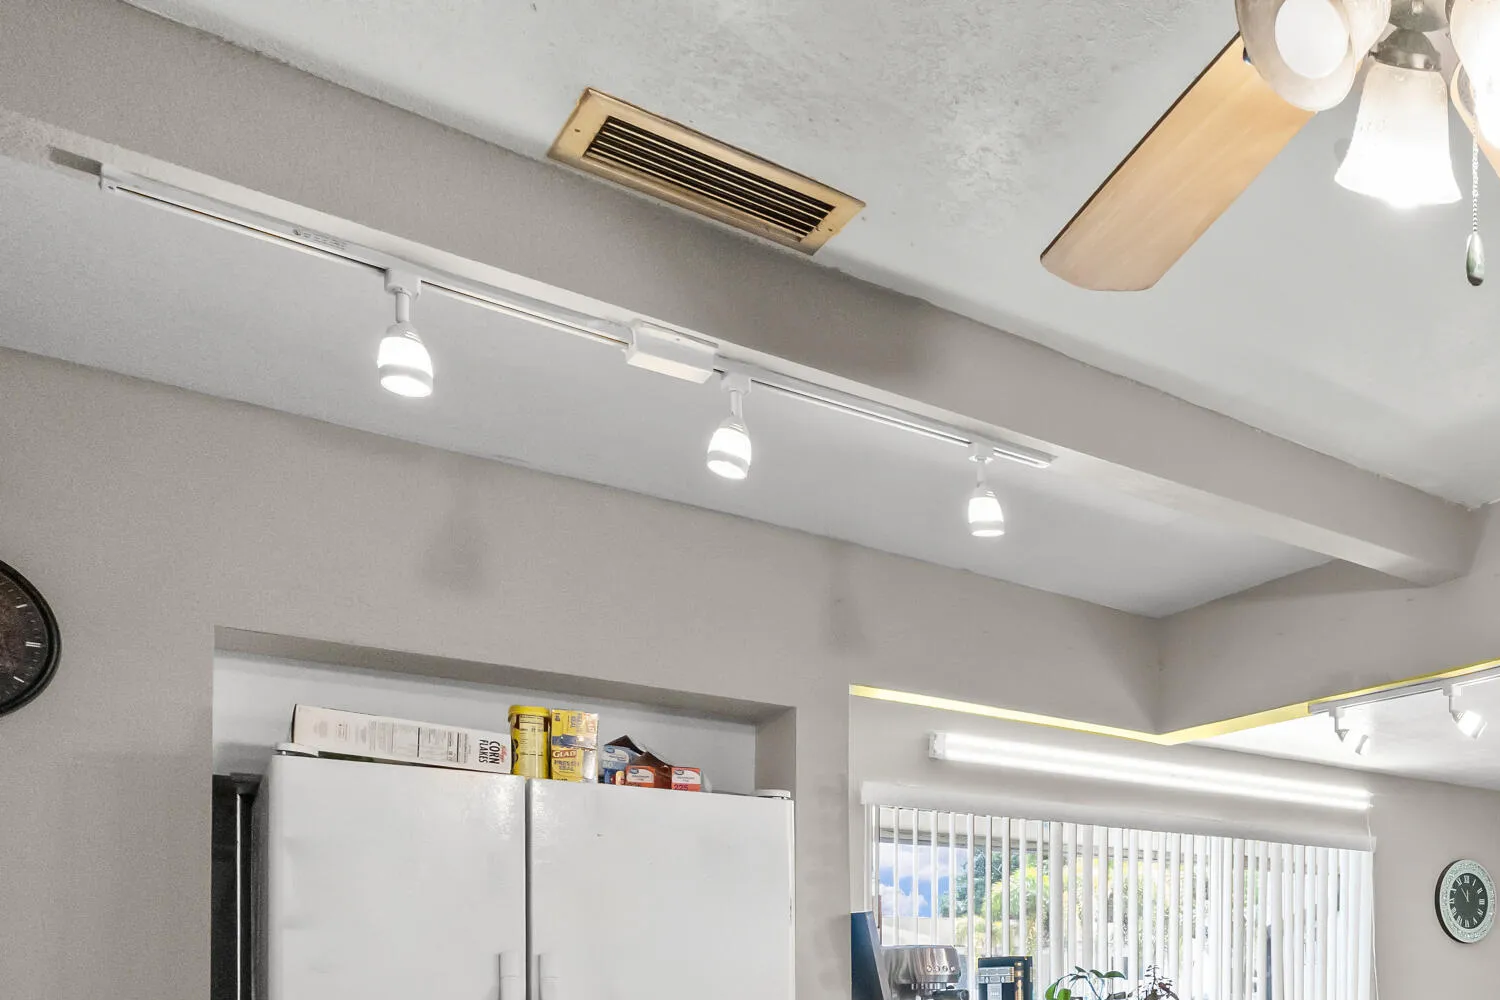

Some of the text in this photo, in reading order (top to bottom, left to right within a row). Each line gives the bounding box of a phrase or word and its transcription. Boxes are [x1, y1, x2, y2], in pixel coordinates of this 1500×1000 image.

[479, 739, 489, 764] FLAKES
[489, 741, 501, 764] CORN
[552, 750, 576, 758] GLAD
